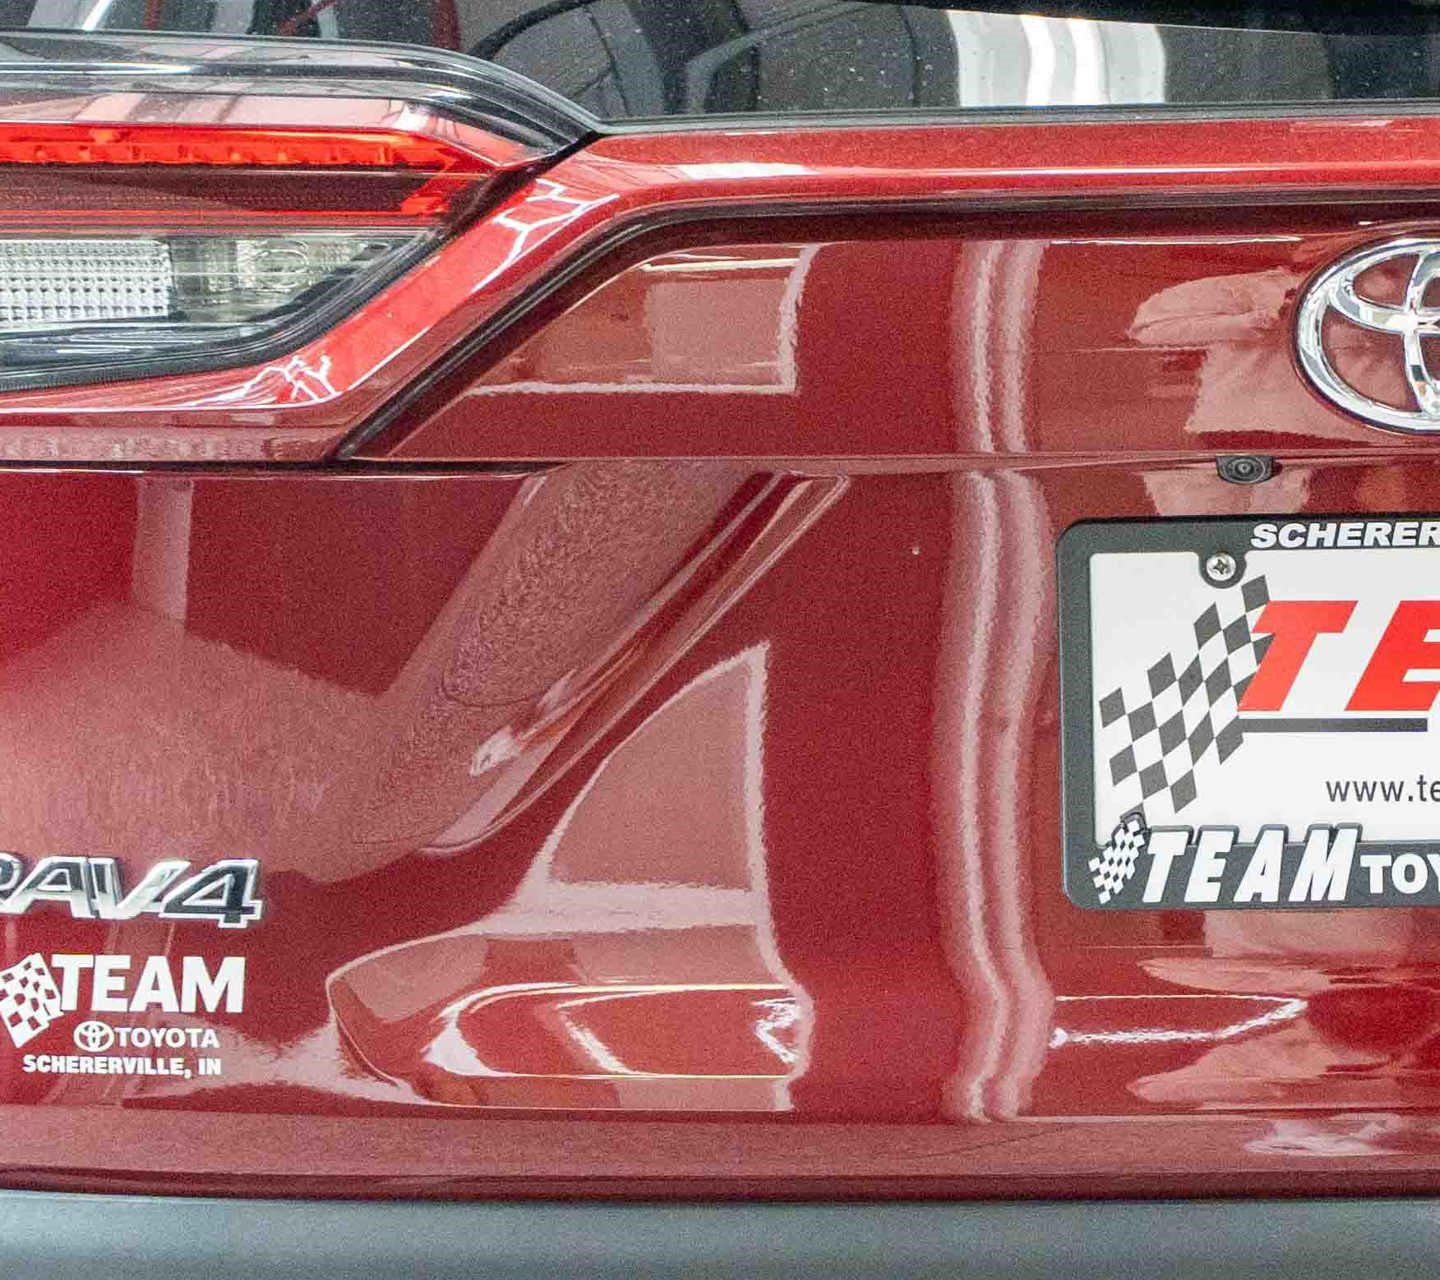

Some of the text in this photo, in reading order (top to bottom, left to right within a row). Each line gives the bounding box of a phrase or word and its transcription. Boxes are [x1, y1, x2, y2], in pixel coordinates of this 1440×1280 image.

[1142, 829, 1361, 903] TEAM
[51, 953, 247, 1014] TEAM
[114, 1026, 221, 1049] TOYOTA
[22, 1053, 222, 1079] SCHERERVILLE, IN
